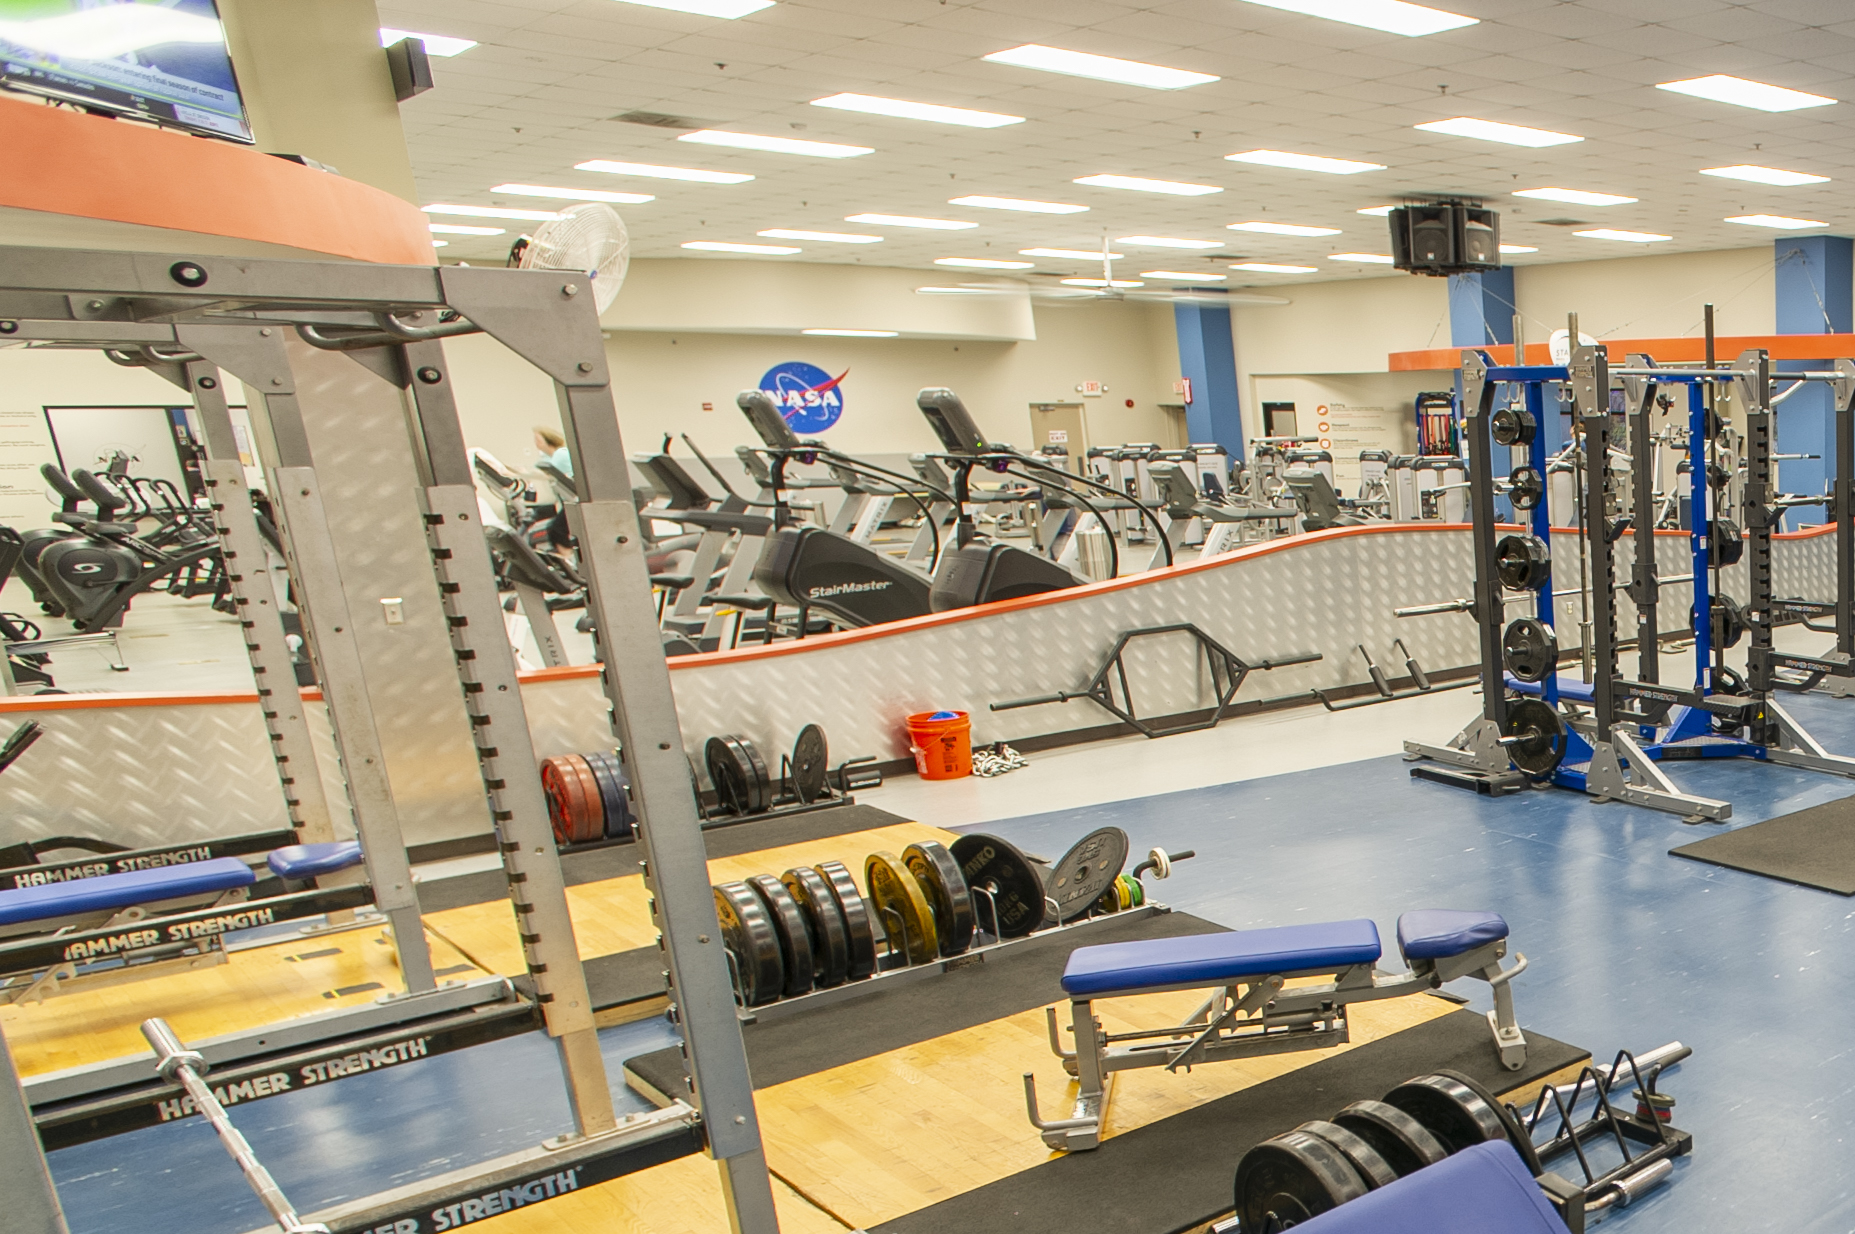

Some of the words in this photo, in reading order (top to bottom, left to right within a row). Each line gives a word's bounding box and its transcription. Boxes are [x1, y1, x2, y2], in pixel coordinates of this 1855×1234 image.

[153, 73, 167, 86] final
[168, 79, 189, 92] season
[199, 87, 224, 101] contract
[764, 389, 841, 408] NASA
[1086, 382, 1098, 392] EXIT
[810, 581, 890, 599] StairMaster
[14, 862, 109, 889] HAMMER
[116, 846, 212, 874] STRENGTH
[167, 908, 274, 942] STRENGTH
[300, 1037, 429, 1086] STRENGTH
[430, 1169, 578, 1233] STRENGTH
